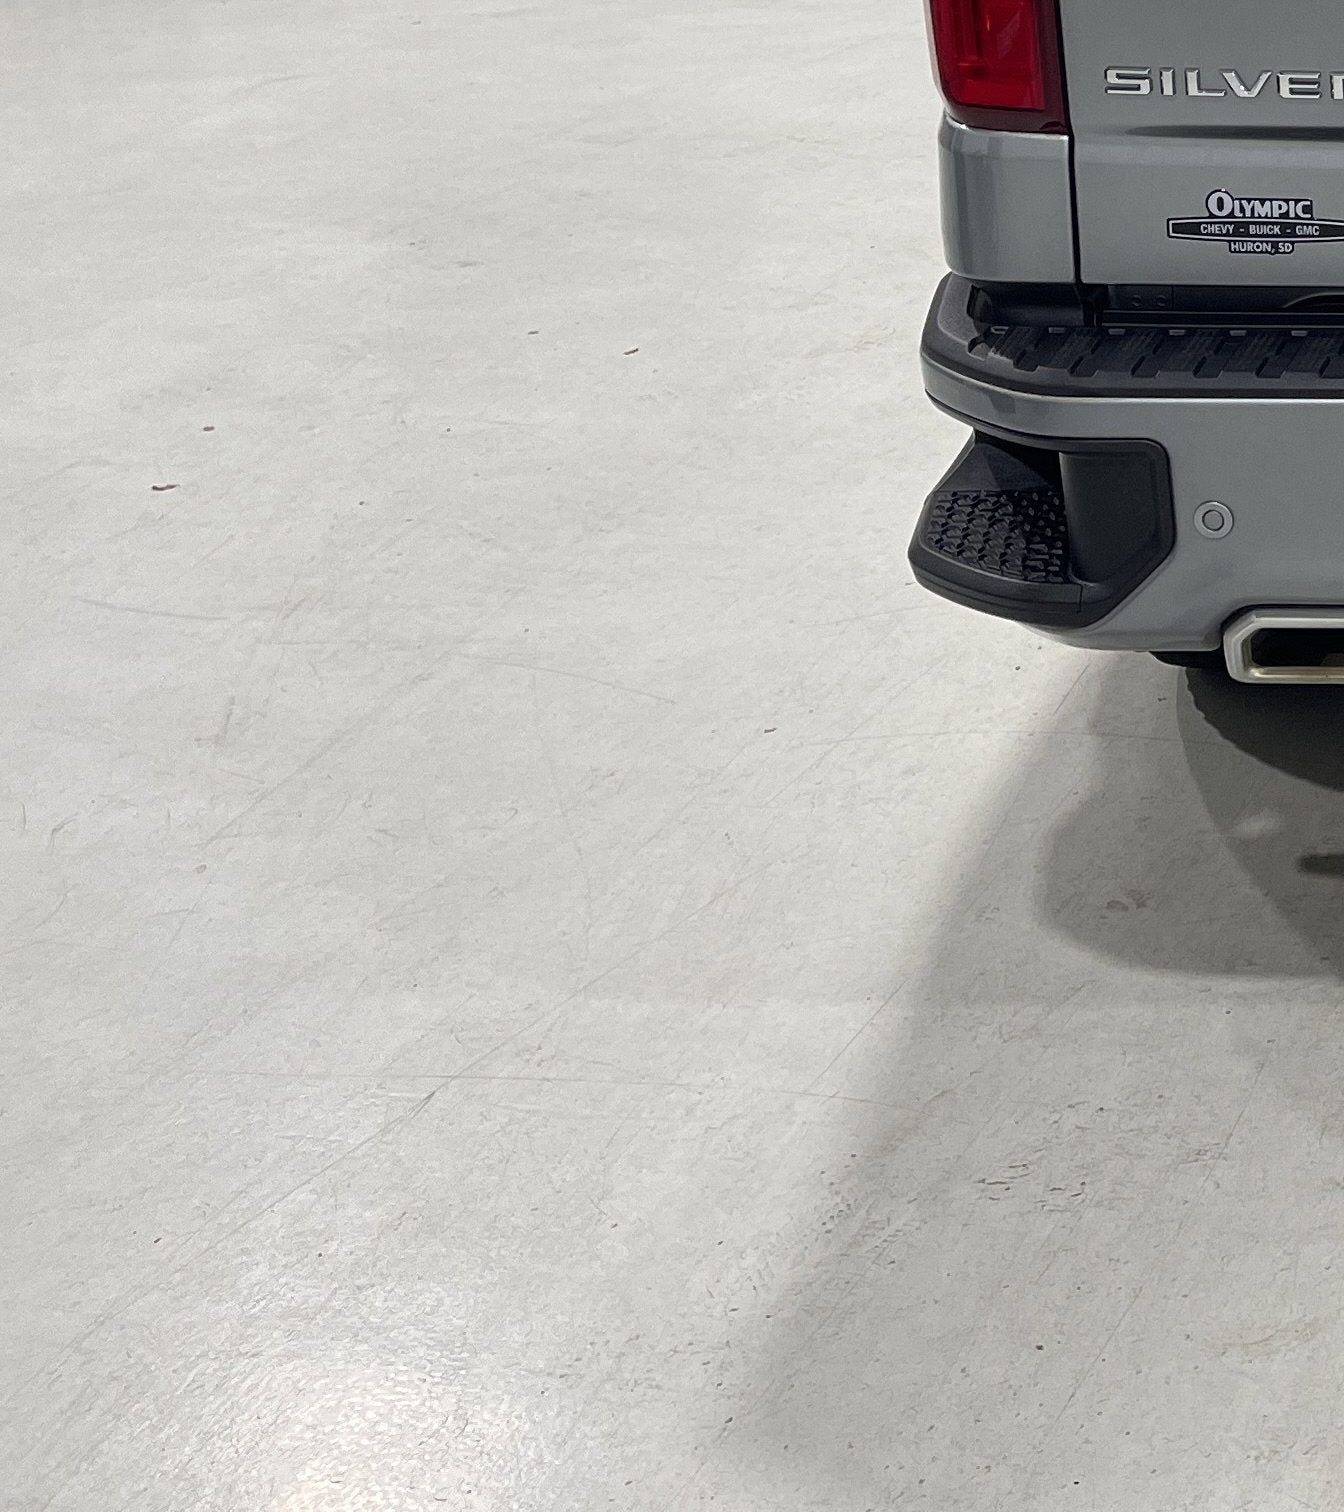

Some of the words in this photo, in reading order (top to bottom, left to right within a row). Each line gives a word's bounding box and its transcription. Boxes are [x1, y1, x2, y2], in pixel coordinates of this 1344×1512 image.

[1207, 190, 1312, 218] OLYMPIC
[1200, 223, 1234, 235] CHEVY
[1249, 224, 1281, 235] BUICK
[1295, 225, 1320, 236] GMC
[1230, 242, 1275, 253] HURON,
[1278, 243, 1293, 252] SD
